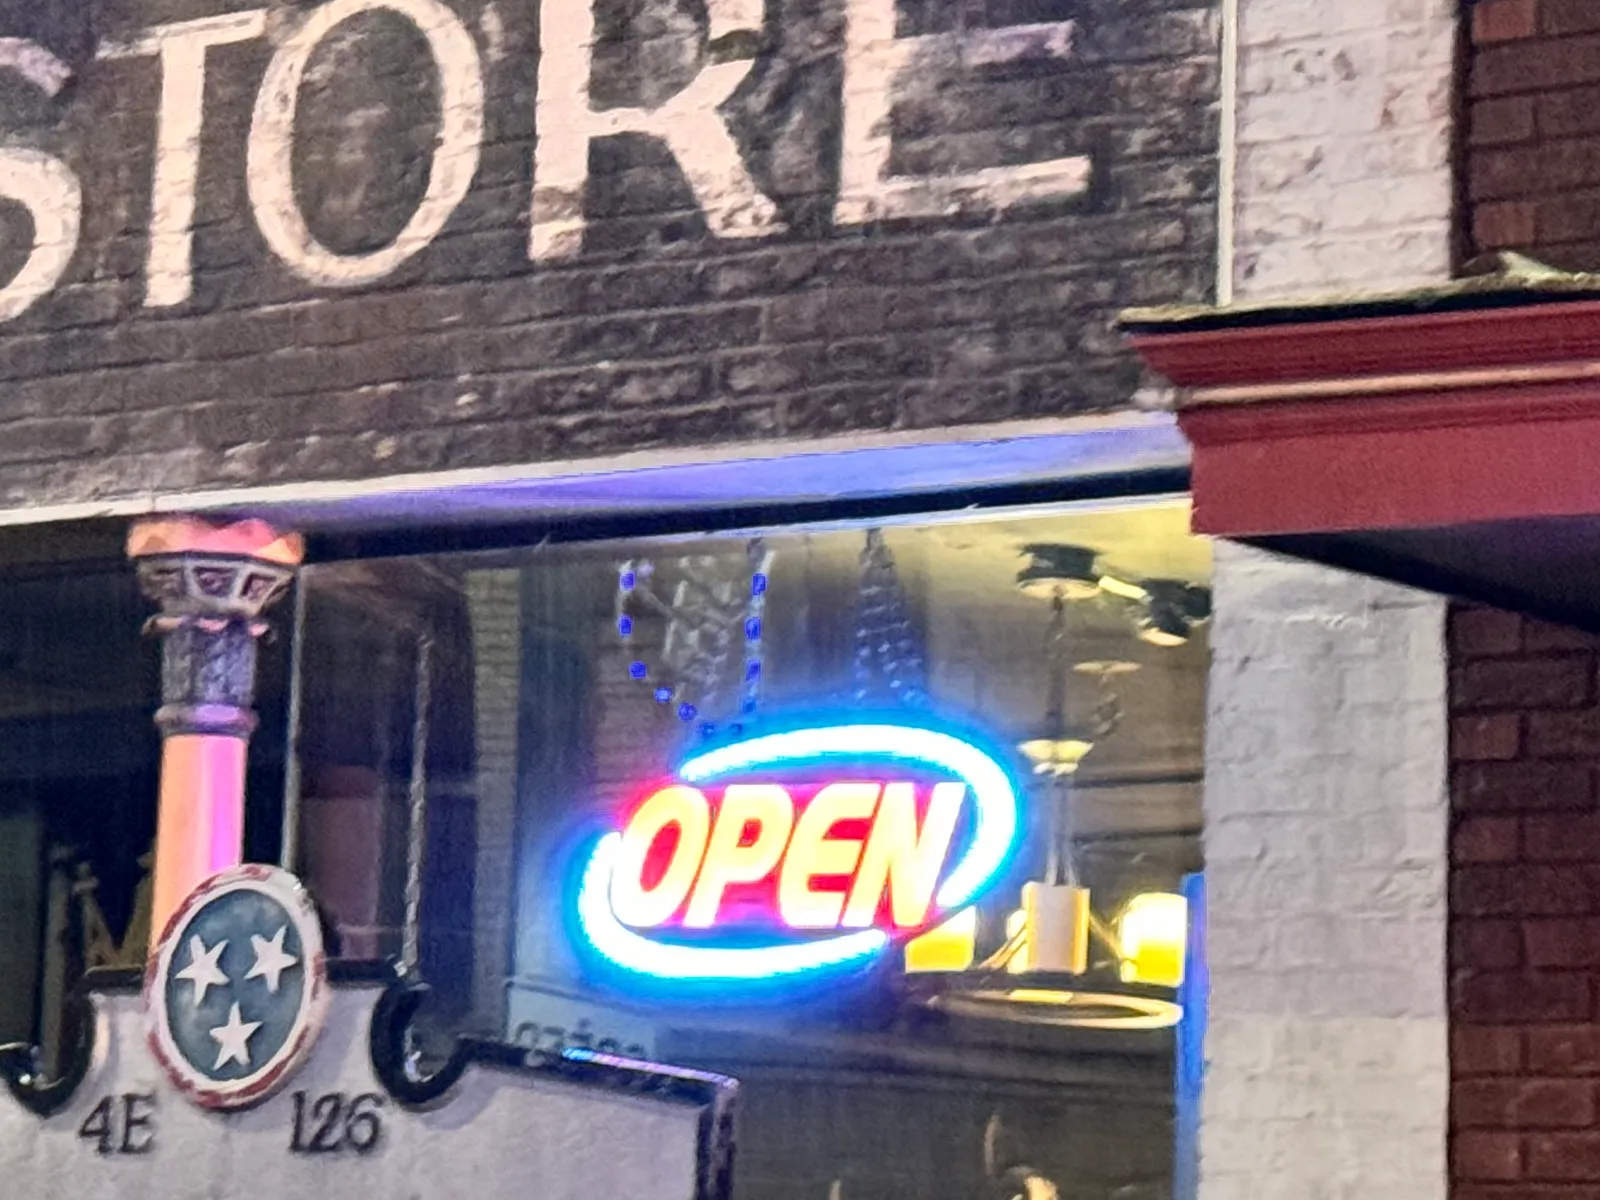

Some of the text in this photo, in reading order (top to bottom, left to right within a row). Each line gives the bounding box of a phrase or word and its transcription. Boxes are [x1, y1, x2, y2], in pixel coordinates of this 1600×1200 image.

[608, 781, 966, 928] OPEN
[78, 1090, 386, 1155] 4E 126
